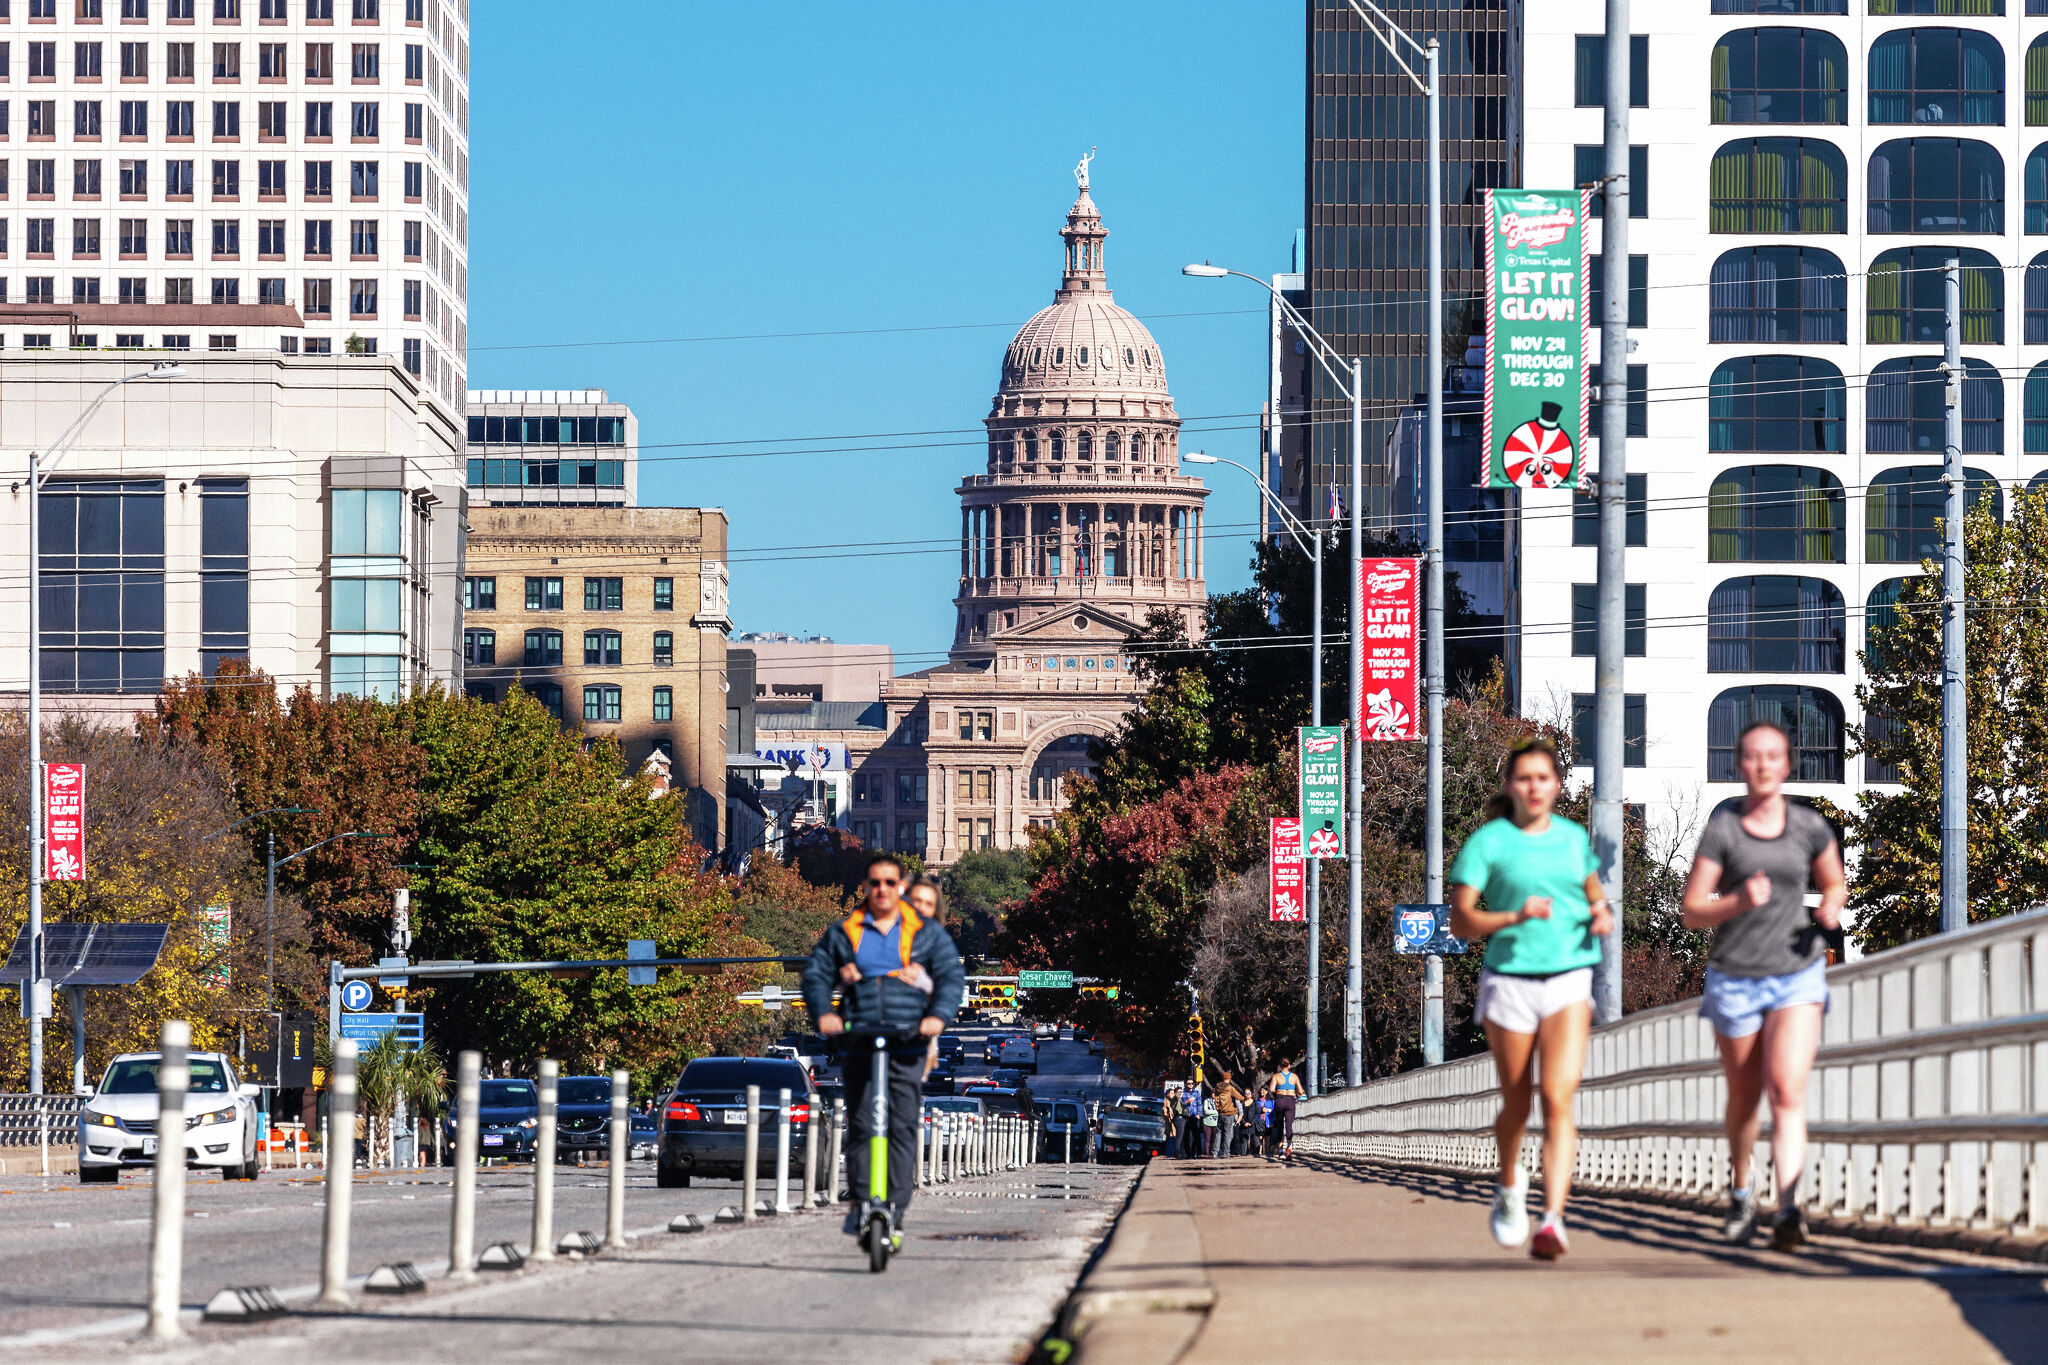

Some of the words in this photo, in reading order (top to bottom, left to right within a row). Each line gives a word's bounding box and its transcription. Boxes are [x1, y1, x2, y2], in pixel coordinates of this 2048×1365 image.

[1542, 256, 1571, 267] Capital
[1501, 271, 1546, 295] LET
[1551, 272, 1575, 296] IT
[1500, 297, 1575, 322] GLOW!
[1510, 336, 1543, 351] NOV
[1545, 336, 1566, 352] 24
[1501, 353, 1574, 370] THROUGH
[1509, 371, 1540, 387] DEC
[1543, 372, 1565, 387] 30
[1367, 608, 1394, 623] LET
[1396, 608, 1411, 623] IT
[1366, 623, 1411, 639] GLOW!
[1372, 647, 1391, 658] NOV
[1391, 647, 1405, 658] 24
[1367, 658, 1410, 668] THROUGH
[1372, 669, 1390, 679] DEC
[1390, 669, 1405, 679] 30
[755, 749, 806, 765] ANK
[1305, 763, 1326, 774] LET
[1327, 763, 1338, 774] IT
[1305, 774, 1339, 785] GLOW!
[1310, 791, 1324, 799] NOV
[1306, 799, 1339, 807] THROUGH
[1310, 807, 1324, 815] DEC
[1325, 807, 1335, 815] 30
[1274, 846, 1290, 855] LET
[1292, 846, 1301, 855] IT
[1405, 920, 1430, 939] 35
[1021, 972, 1041, 981] Cesar
[1044, 972, 1071, 981] Chavez
[349, 985, 366, 1007] P
